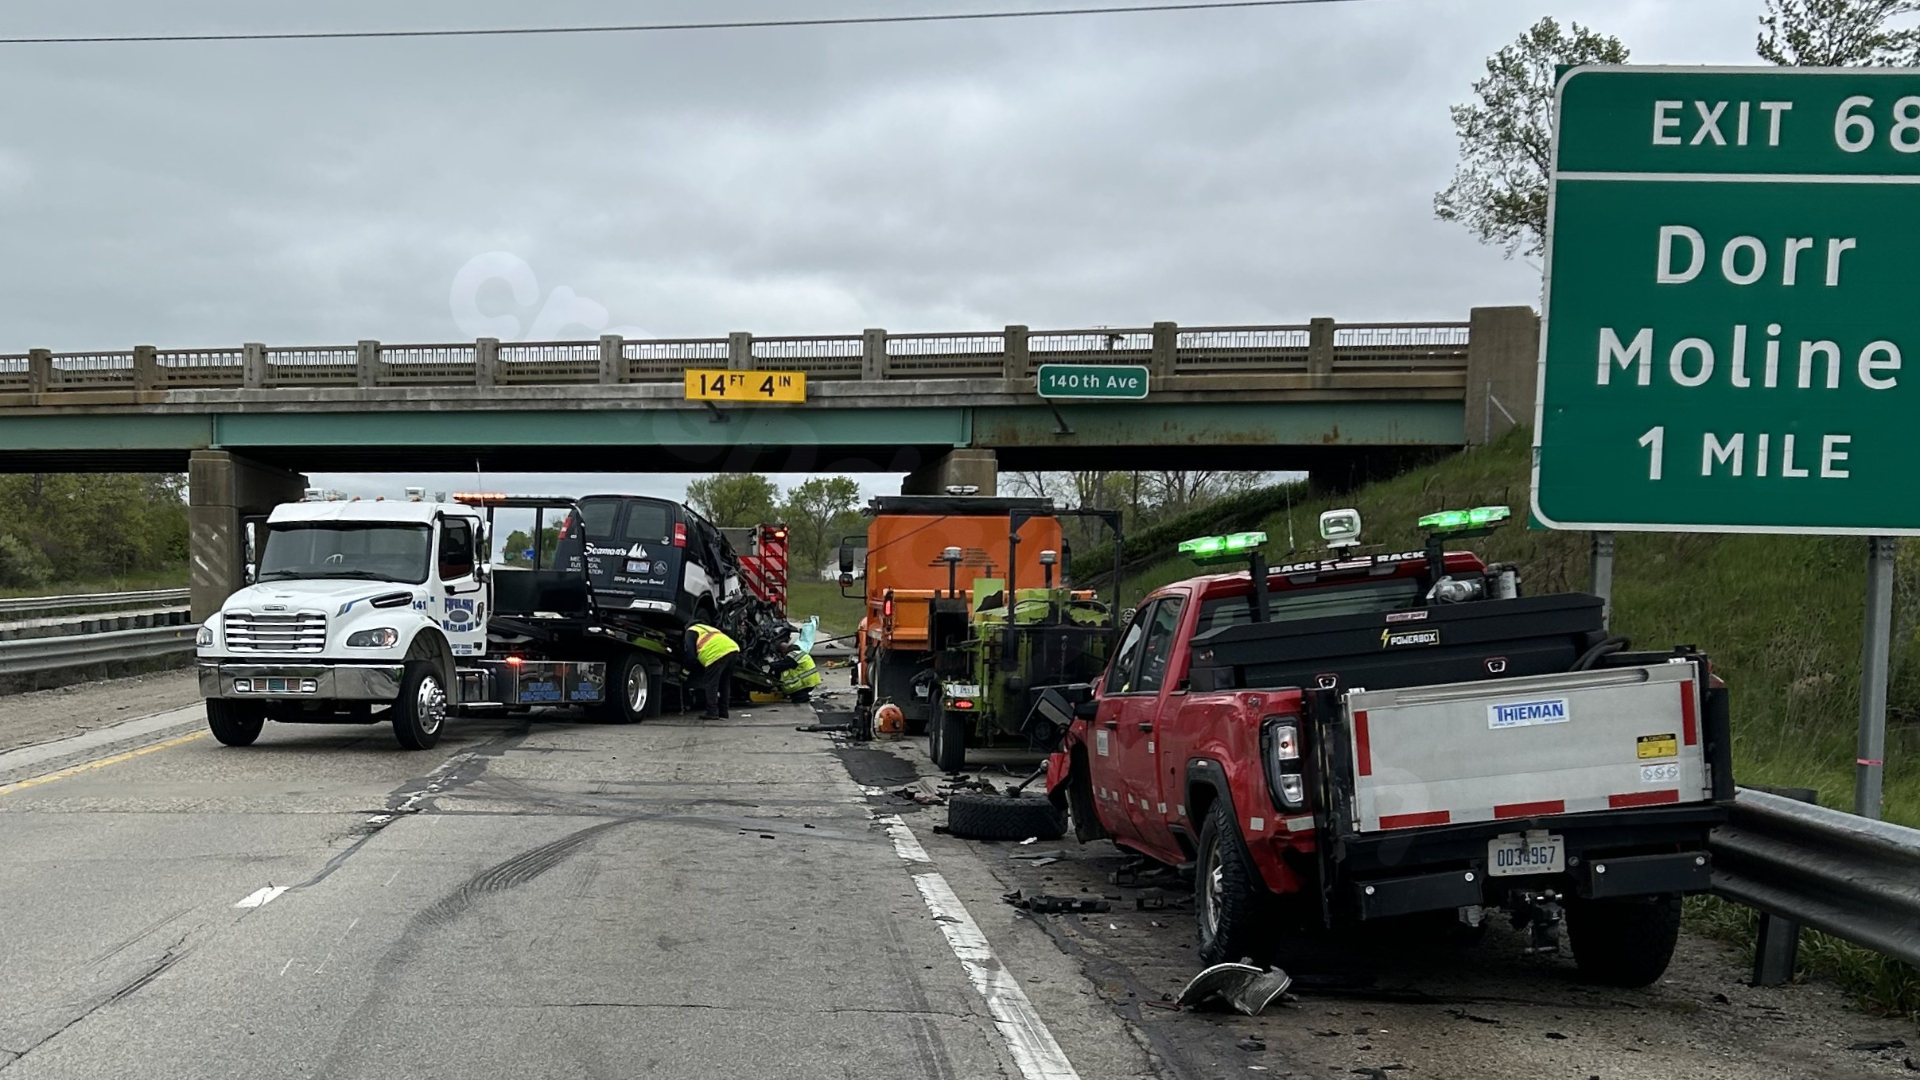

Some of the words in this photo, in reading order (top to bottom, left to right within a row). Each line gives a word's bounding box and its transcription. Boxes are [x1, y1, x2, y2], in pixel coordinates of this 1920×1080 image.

[1652, 100, 1793, 146] EXIT
[1834, 95, 1920, 153] 68
[1656, 225, 1857, 287] Dorr
[1596, 322, 1902, 390] Moline
[700, 374, 726, 396] 14
[730, 374, 745, 386] FT
[759, 375, 775, 397] 4
[779, 375, 791, 387] IN
[1049, 374, 1100, 388] 140th
[1106, 375, 1139, 389] Ave
[1638, 425, 1665, 481] 1
[1701, 432, 1852, 479] MILE
[1268, 561, 1317, 575] BACK
[1377, 551, 1426, 563] RACK
[412, 600, 427, 610] 141
[1390, 633, 1436, 646] POWERBOX
[1492, 699, 1564, 722] THIEMAN
[1497, 845, 1556, 867] 0034967
